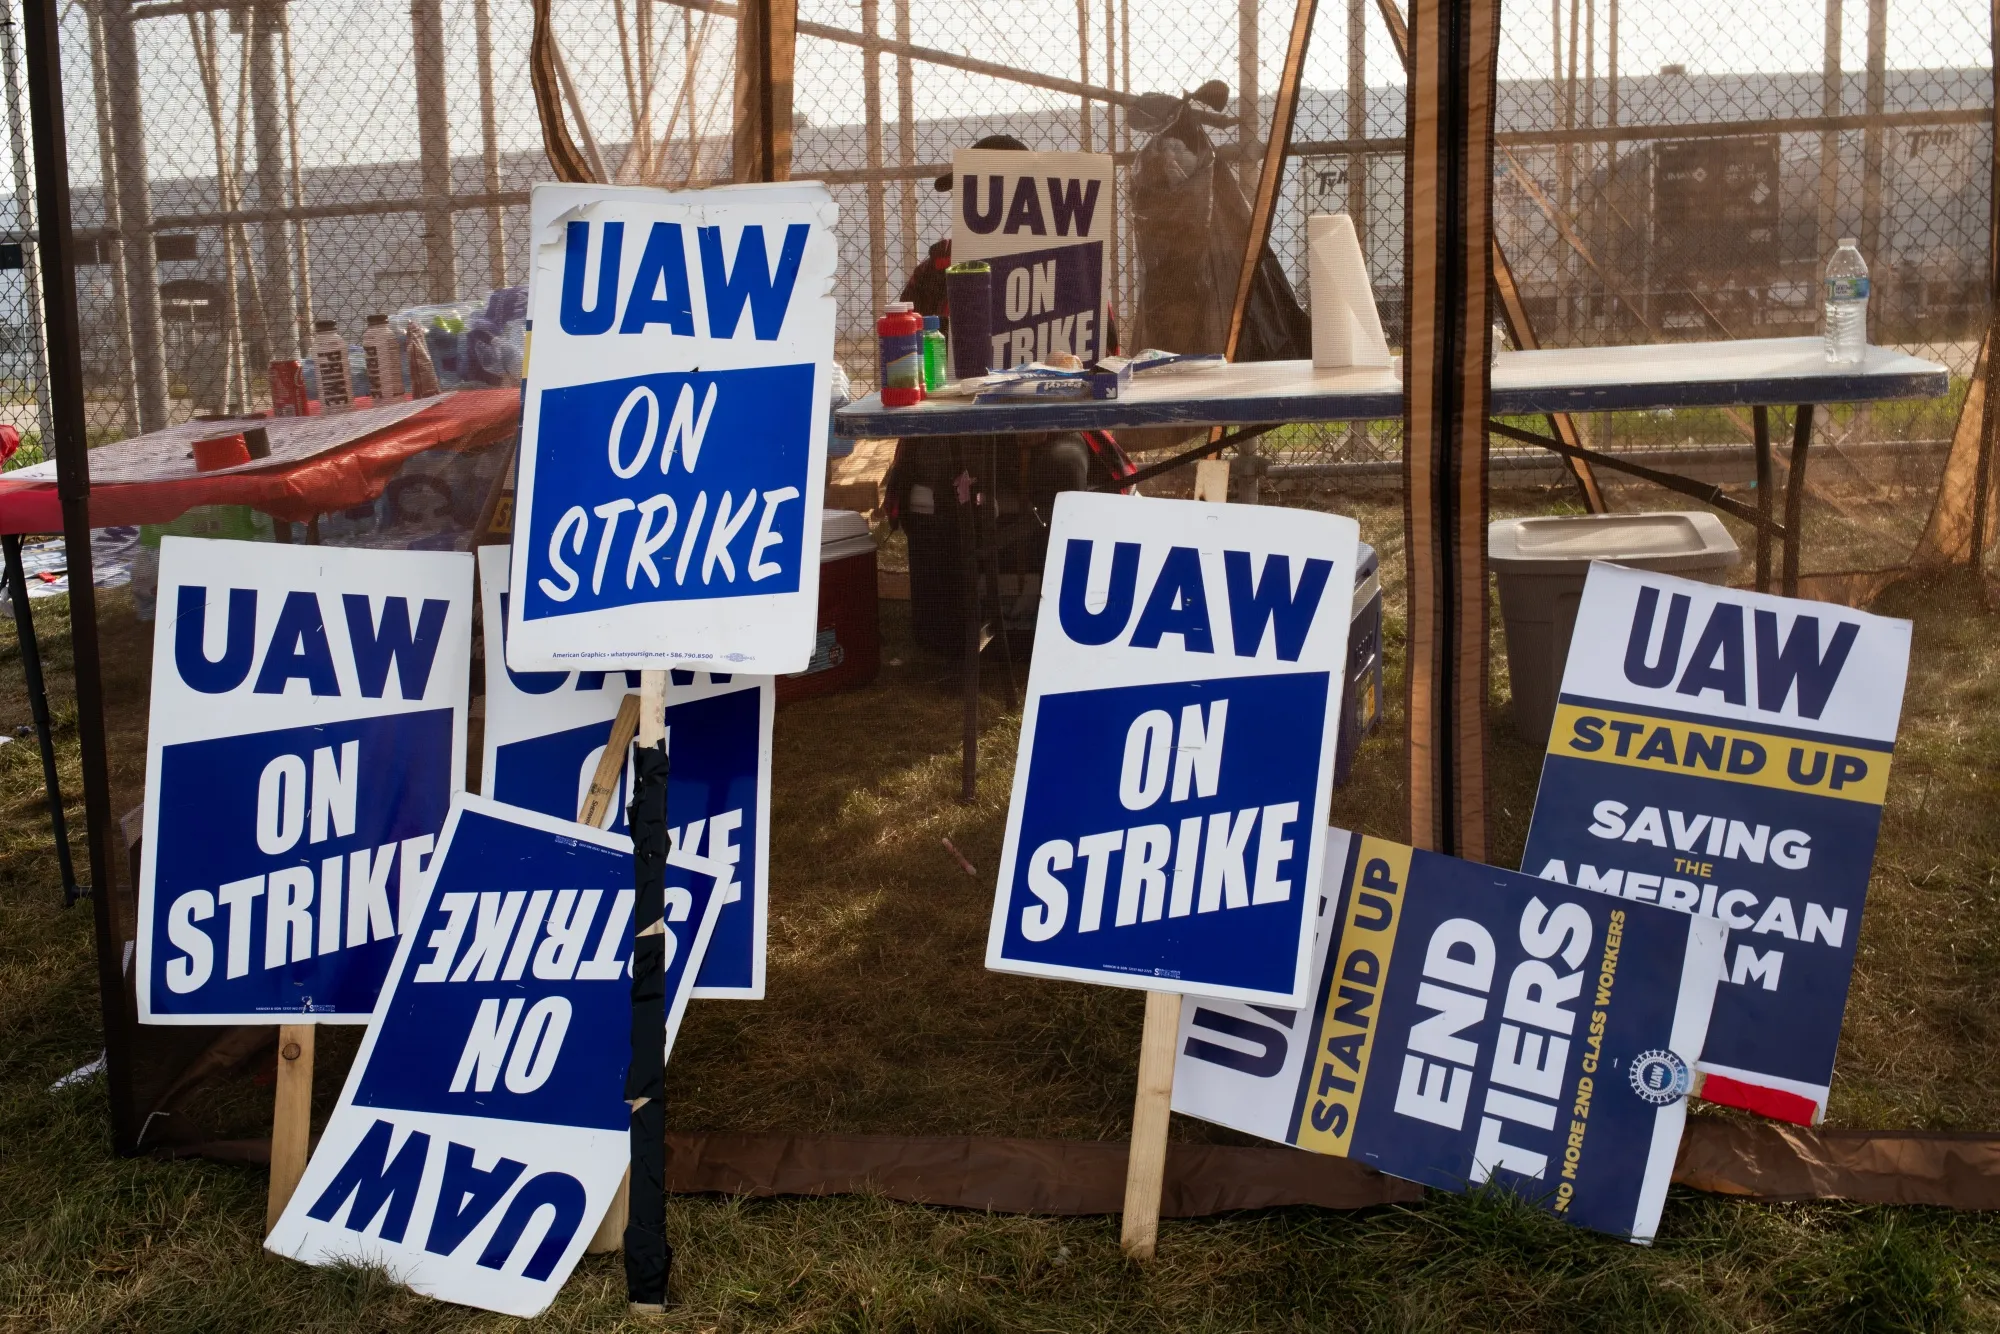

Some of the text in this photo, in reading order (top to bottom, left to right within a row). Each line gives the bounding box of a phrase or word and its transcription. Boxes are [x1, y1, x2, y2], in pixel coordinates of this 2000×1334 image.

[963, 175, 1101, 237] UAW
[560, 221, 811, 341] UAW
[1005, 260, 1057, 322] ON
[317, 350, 348, 406] PRIME
[991, 310, 1094, 369] TRIKE
[609, 381, 718, 480] ON
[538, 486, 800, 602] STRIKE
[175, 585, 450, 700] UAW
[552, 651, 580, 659] American
[580, 651, 606, 659] Graphics
[610, 650, 666, 658] whatsyoursign.net
[1059, 539, 1334, 662] UAW
[1623, 585, 1861, 720] UAW
[256, 740, 360, 855] ON
[1119, 699, 1229, 811] ON
[1568, 716, 1868, 791] STAND UP
[1021, 801, 1299, 942] STRIKE
[1587, 800, 1812, 869] SAVING
[1674, 858, 1713, 878] THE
[1538, 858, 1848, 948] AMERICAN
[448, 996, 572, 1093] ON
[1311, 858, 1399, 1138] STAND UP
[1394, 918, 1496, 1131] END
[1469, 896, 1593, 1184] TIERS
[1555, 909, 1626, 1213] NO MORE 2ND CLASS WORKERS
[1649, 1064, 1665, 1088] UAW
[306, 1119, 587, 1282] UAW
